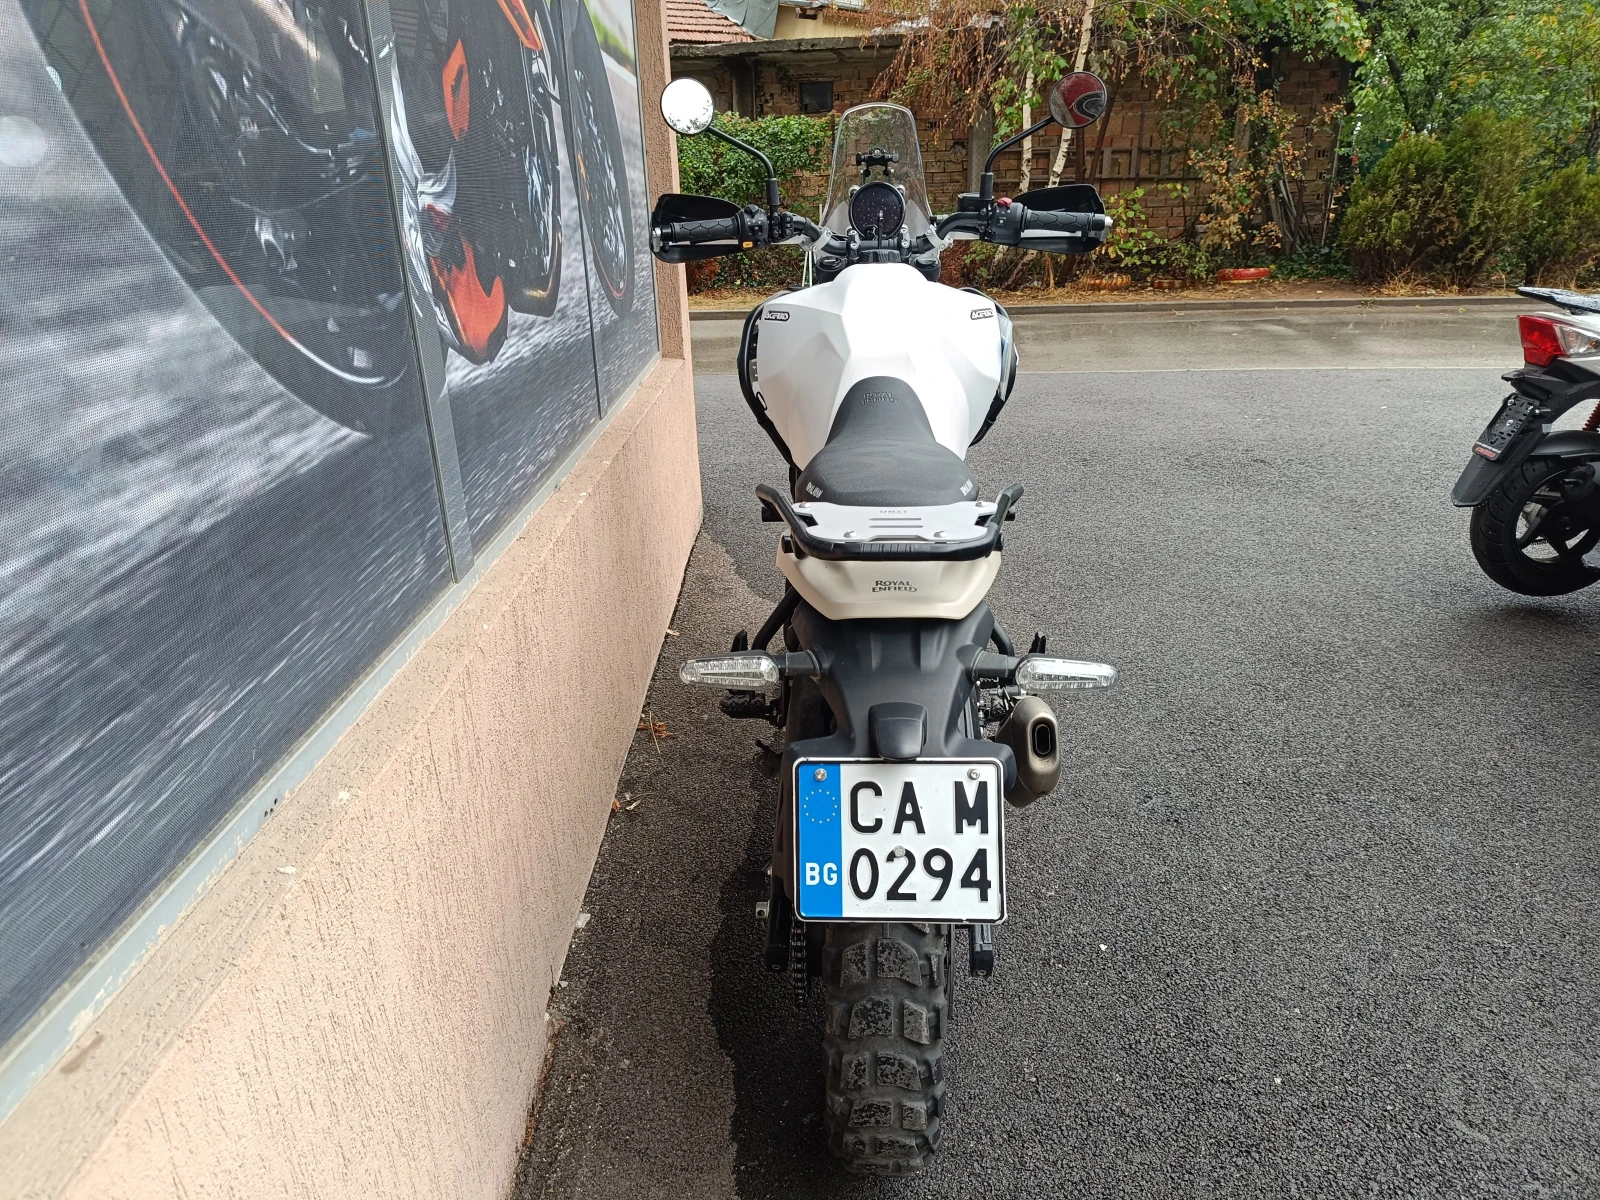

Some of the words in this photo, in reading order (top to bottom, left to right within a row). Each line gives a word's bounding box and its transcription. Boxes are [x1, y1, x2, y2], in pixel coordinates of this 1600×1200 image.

[850, 781, 926, 834] CA
[954, 780, 989, 834] M
[805, 862, 838, 886] BG
[849, 847, 992, 902] 0294
